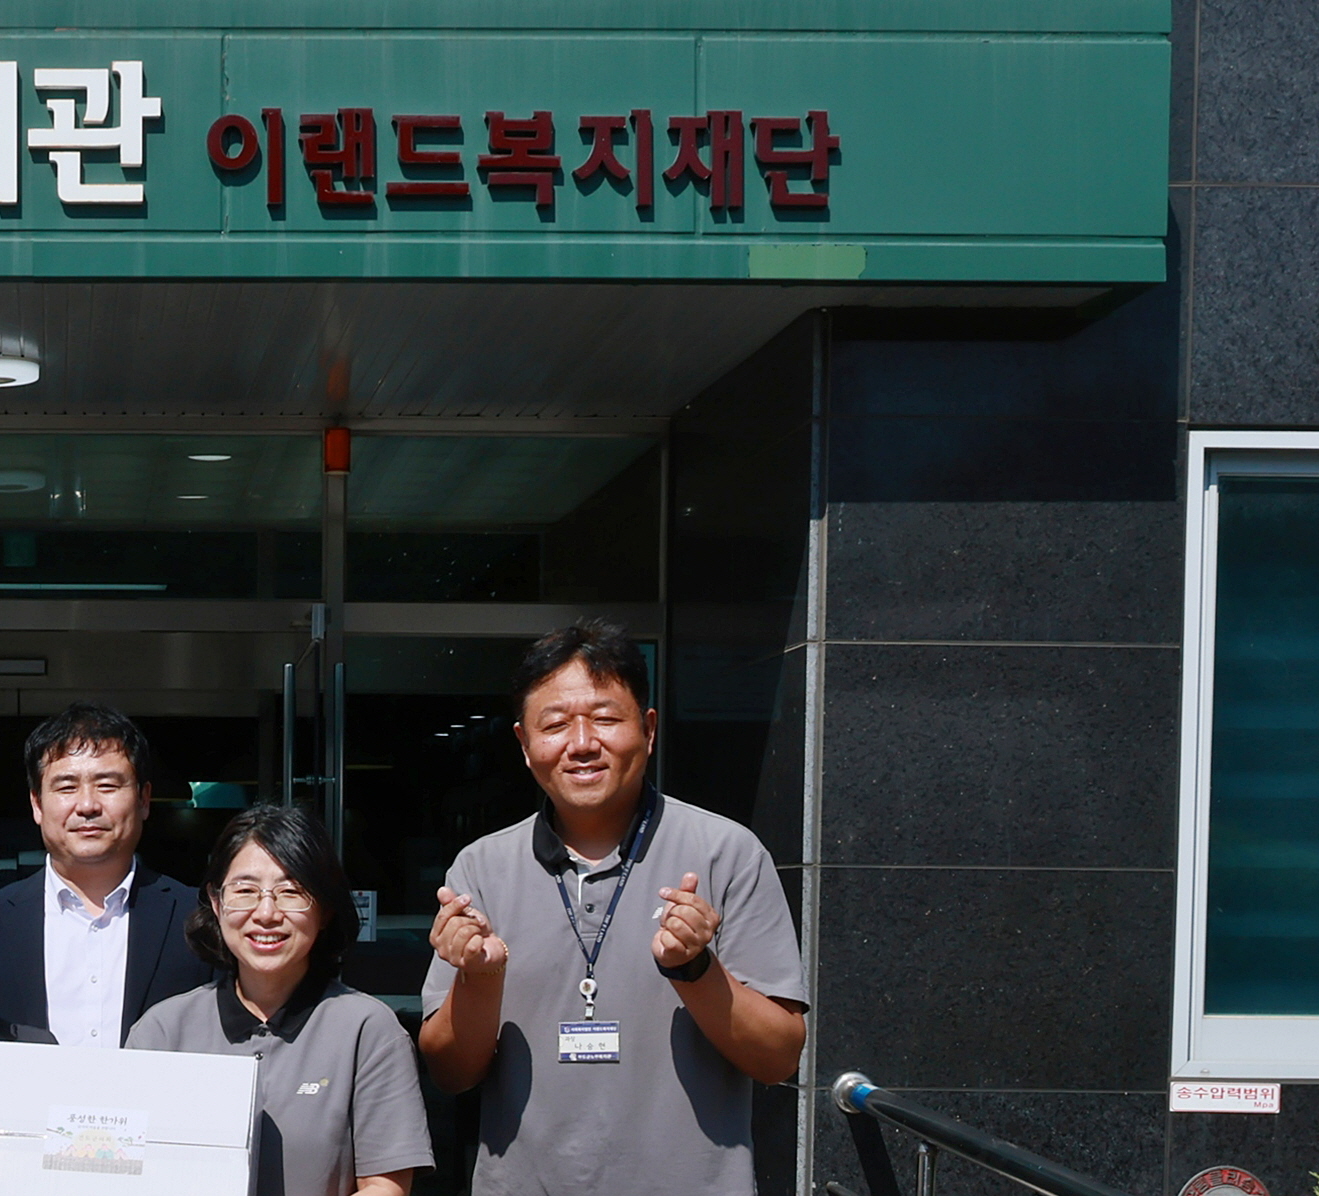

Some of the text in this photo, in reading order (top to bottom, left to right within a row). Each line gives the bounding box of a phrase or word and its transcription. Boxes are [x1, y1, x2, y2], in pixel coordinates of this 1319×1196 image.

[207, 108, 840, 210] 이랜드복지재단
[1176, 1086, 1275, 1100] 송수압력범위
[1254, 1101, 1275, 1109] Mpa
